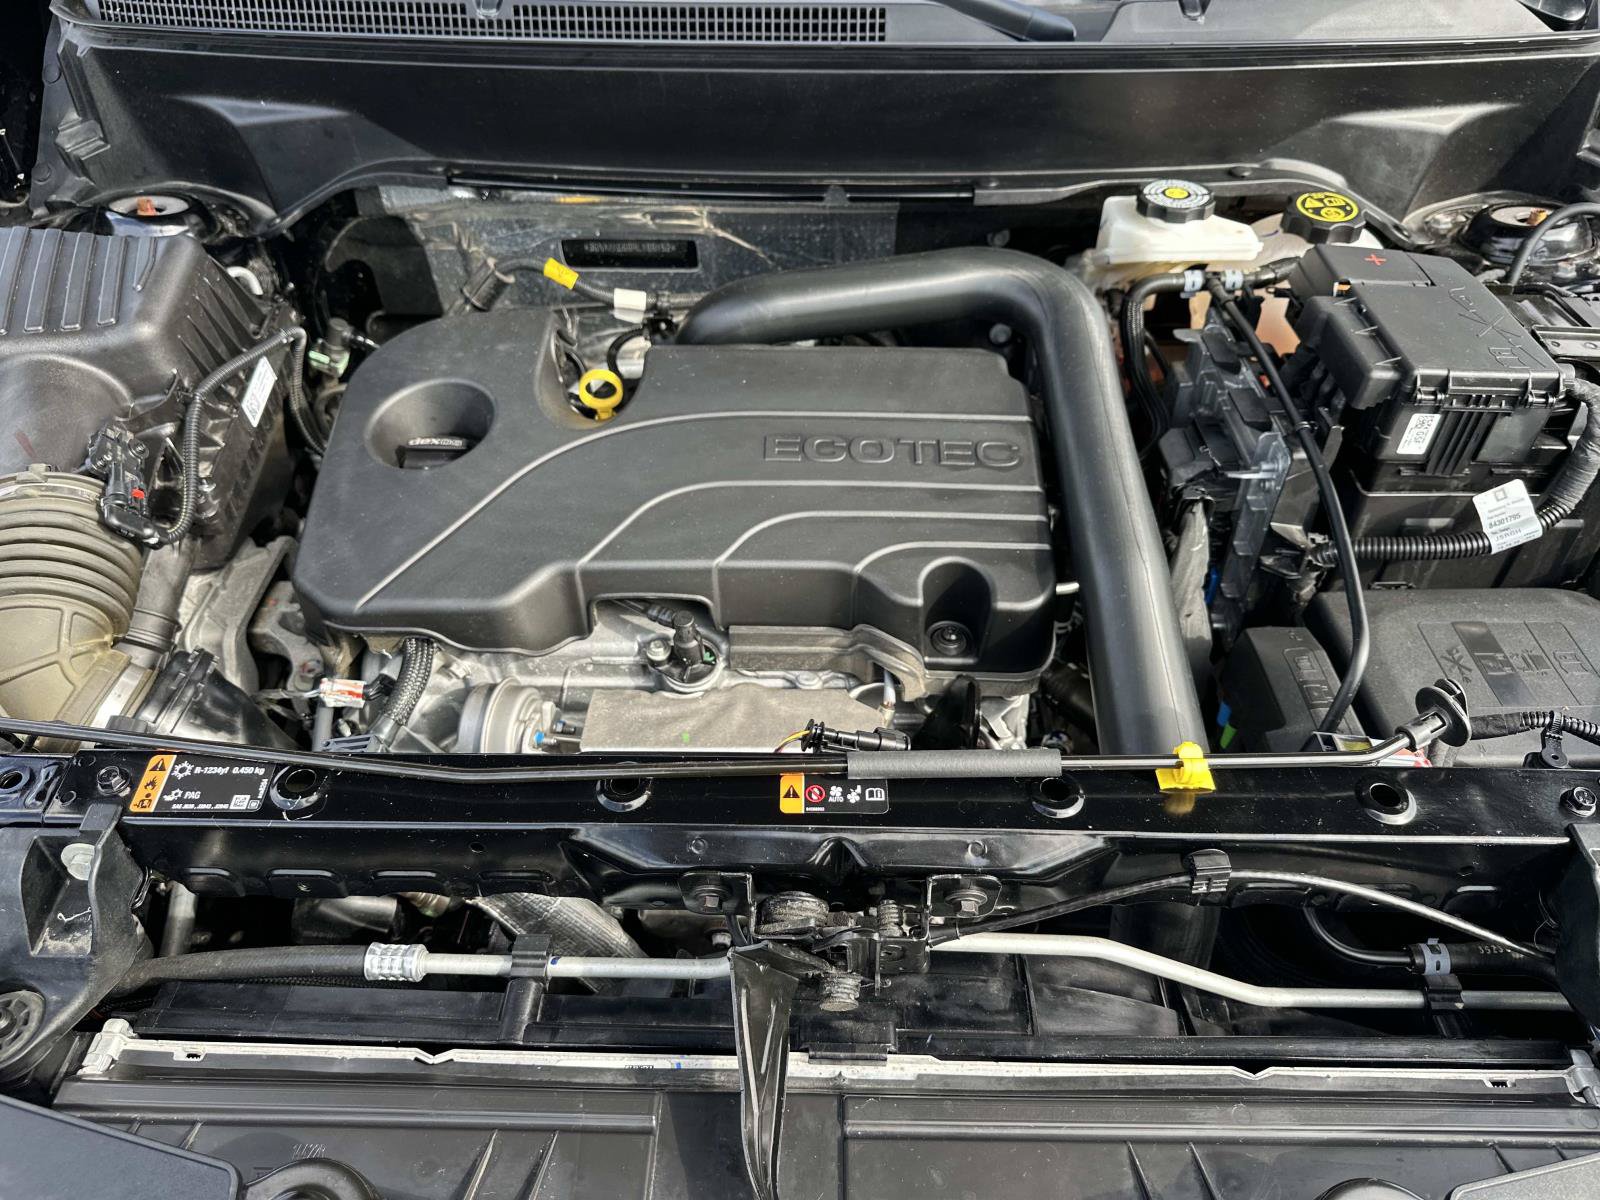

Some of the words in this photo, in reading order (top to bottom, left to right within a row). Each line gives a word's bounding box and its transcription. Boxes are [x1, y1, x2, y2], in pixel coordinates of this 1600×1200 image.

[763, 436, 1021, 467] ECOTEC
[232, 766, 254, 774] 0.450
[254, 766, 266, 775] kg
[184, 791, 201, 799] PAG
